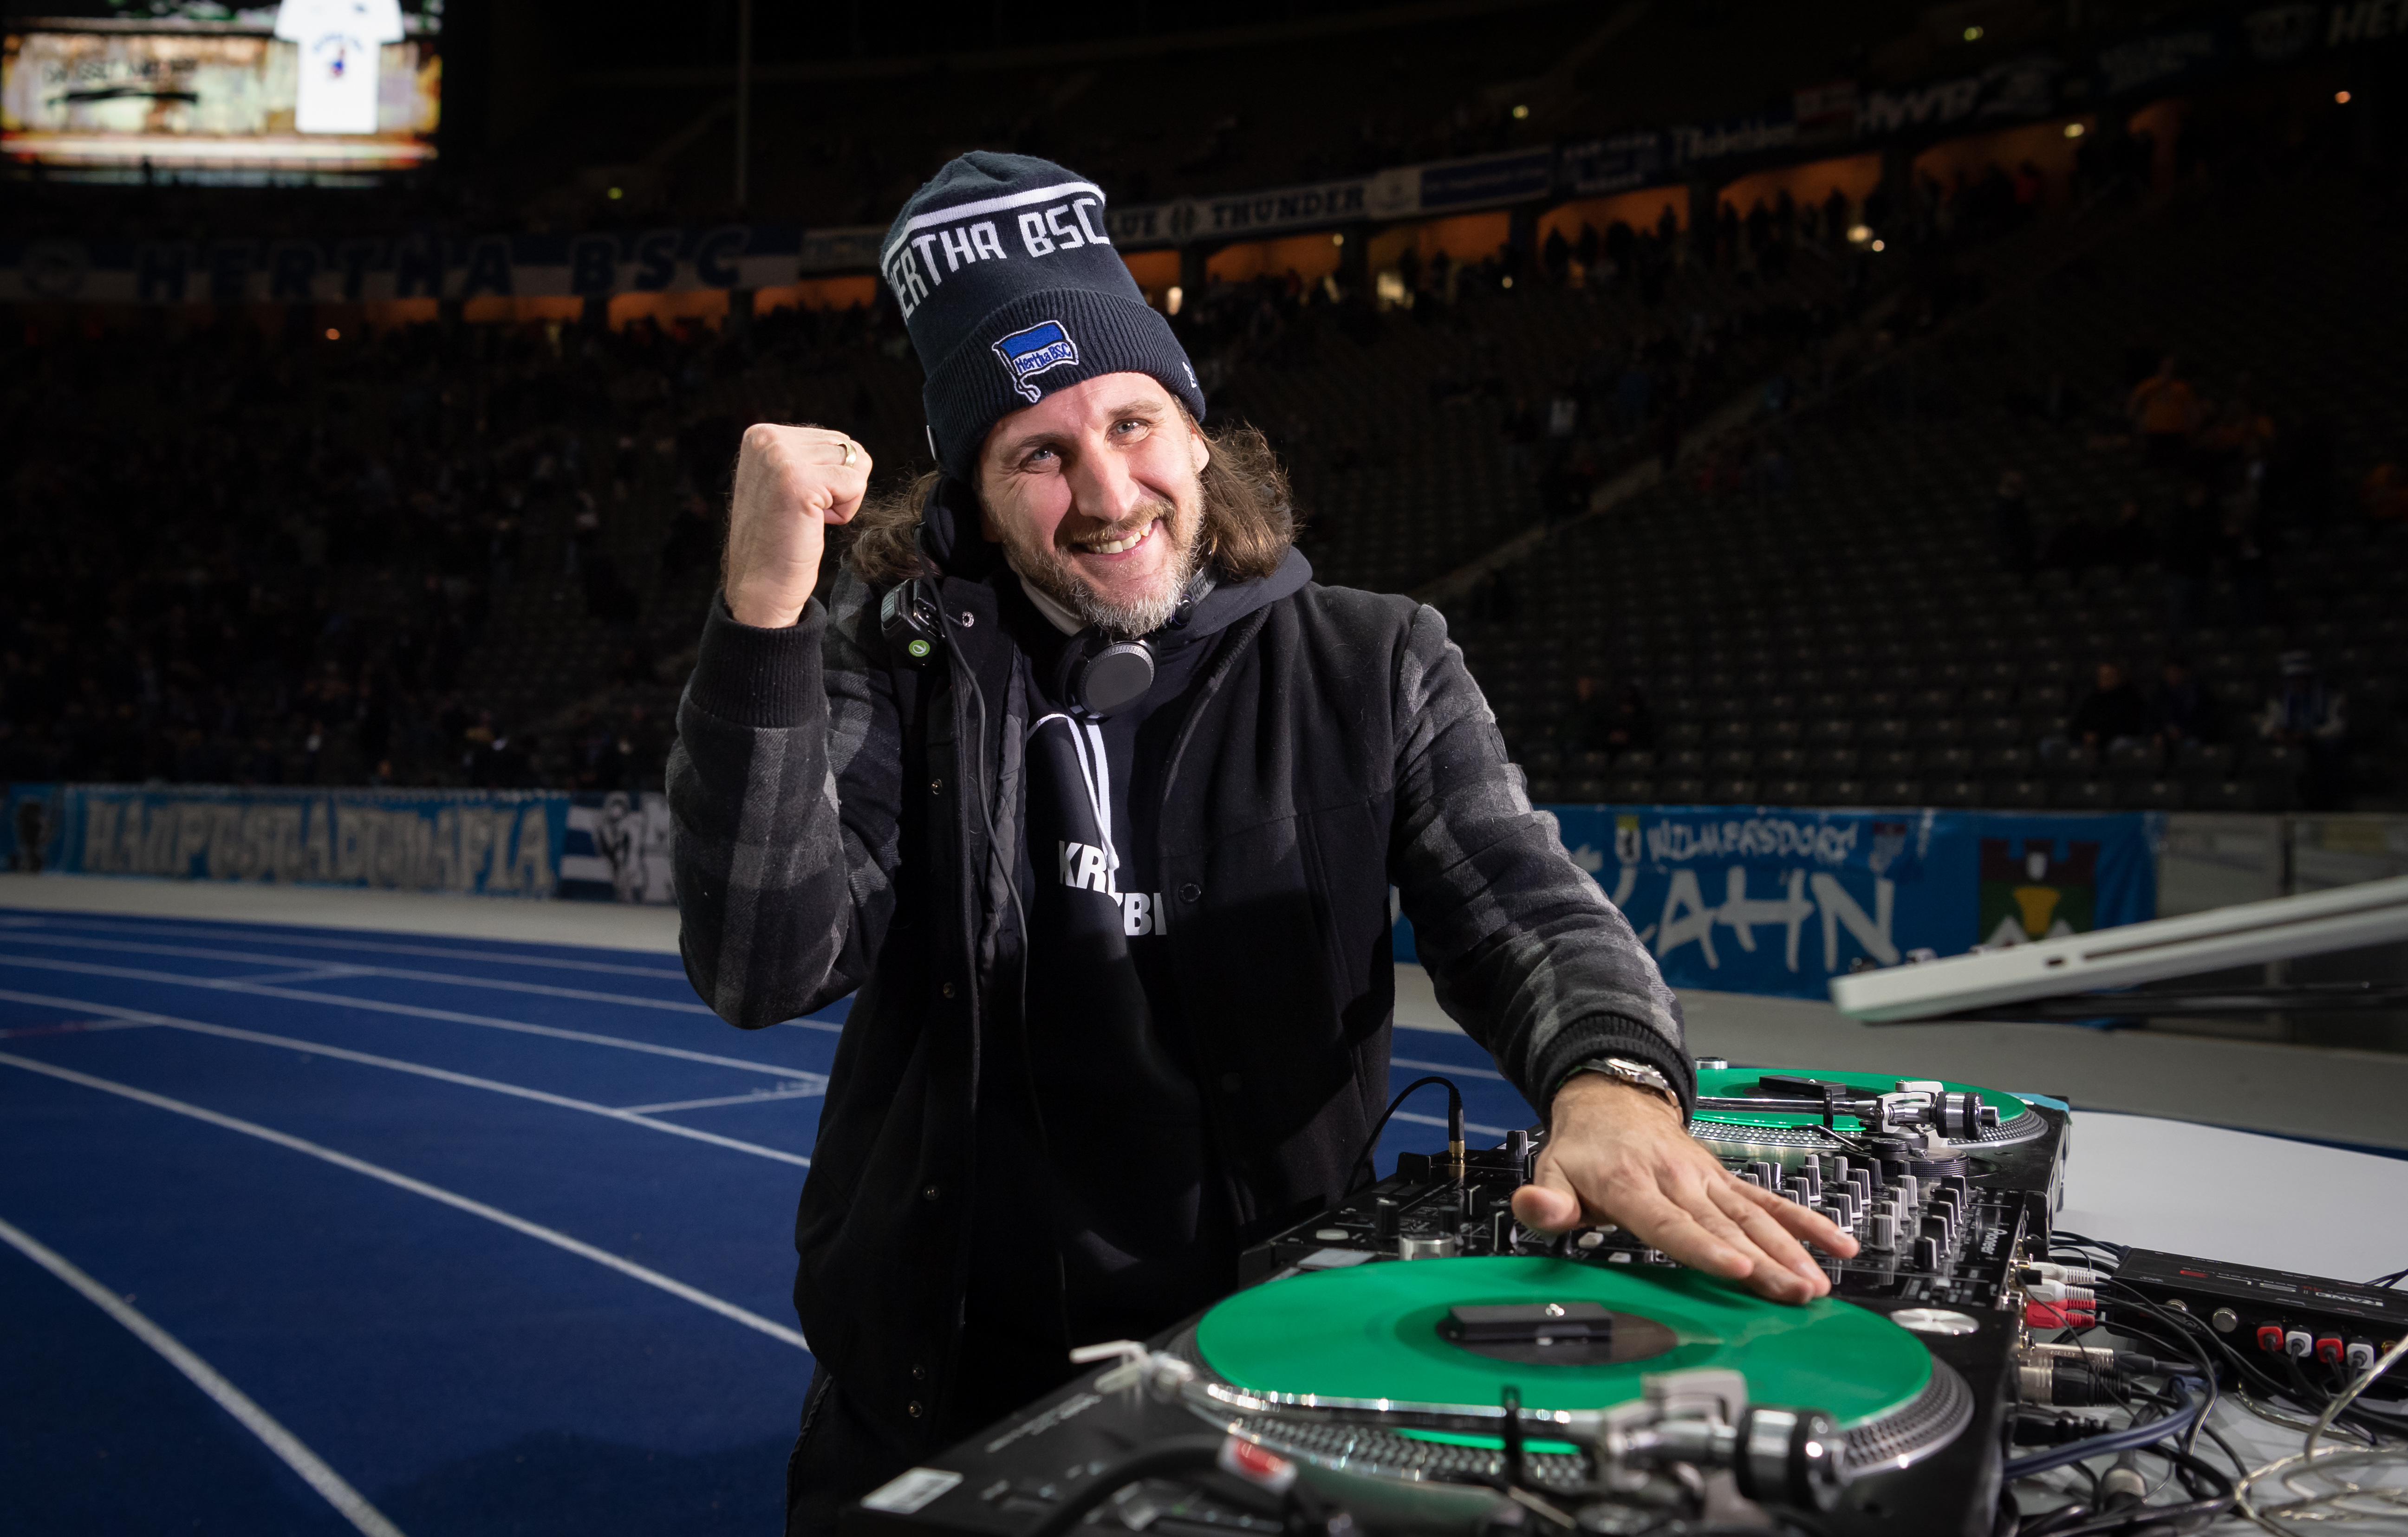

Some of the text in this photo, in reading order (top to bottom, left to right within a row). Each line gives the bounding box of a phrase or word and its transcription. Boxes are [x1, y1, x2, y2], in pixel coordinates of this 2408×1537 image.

[1212, 186, 1365, 226] THUNDER
[1018, 198, 1110, 258] BSC
[134, 238, 514, 303] HERTHA
[569, 226, 751, 298] BSC
[1014, 343, 1072, 374] Hertha BSC
[1981, 1227, 2008, 1255] Pioneer
